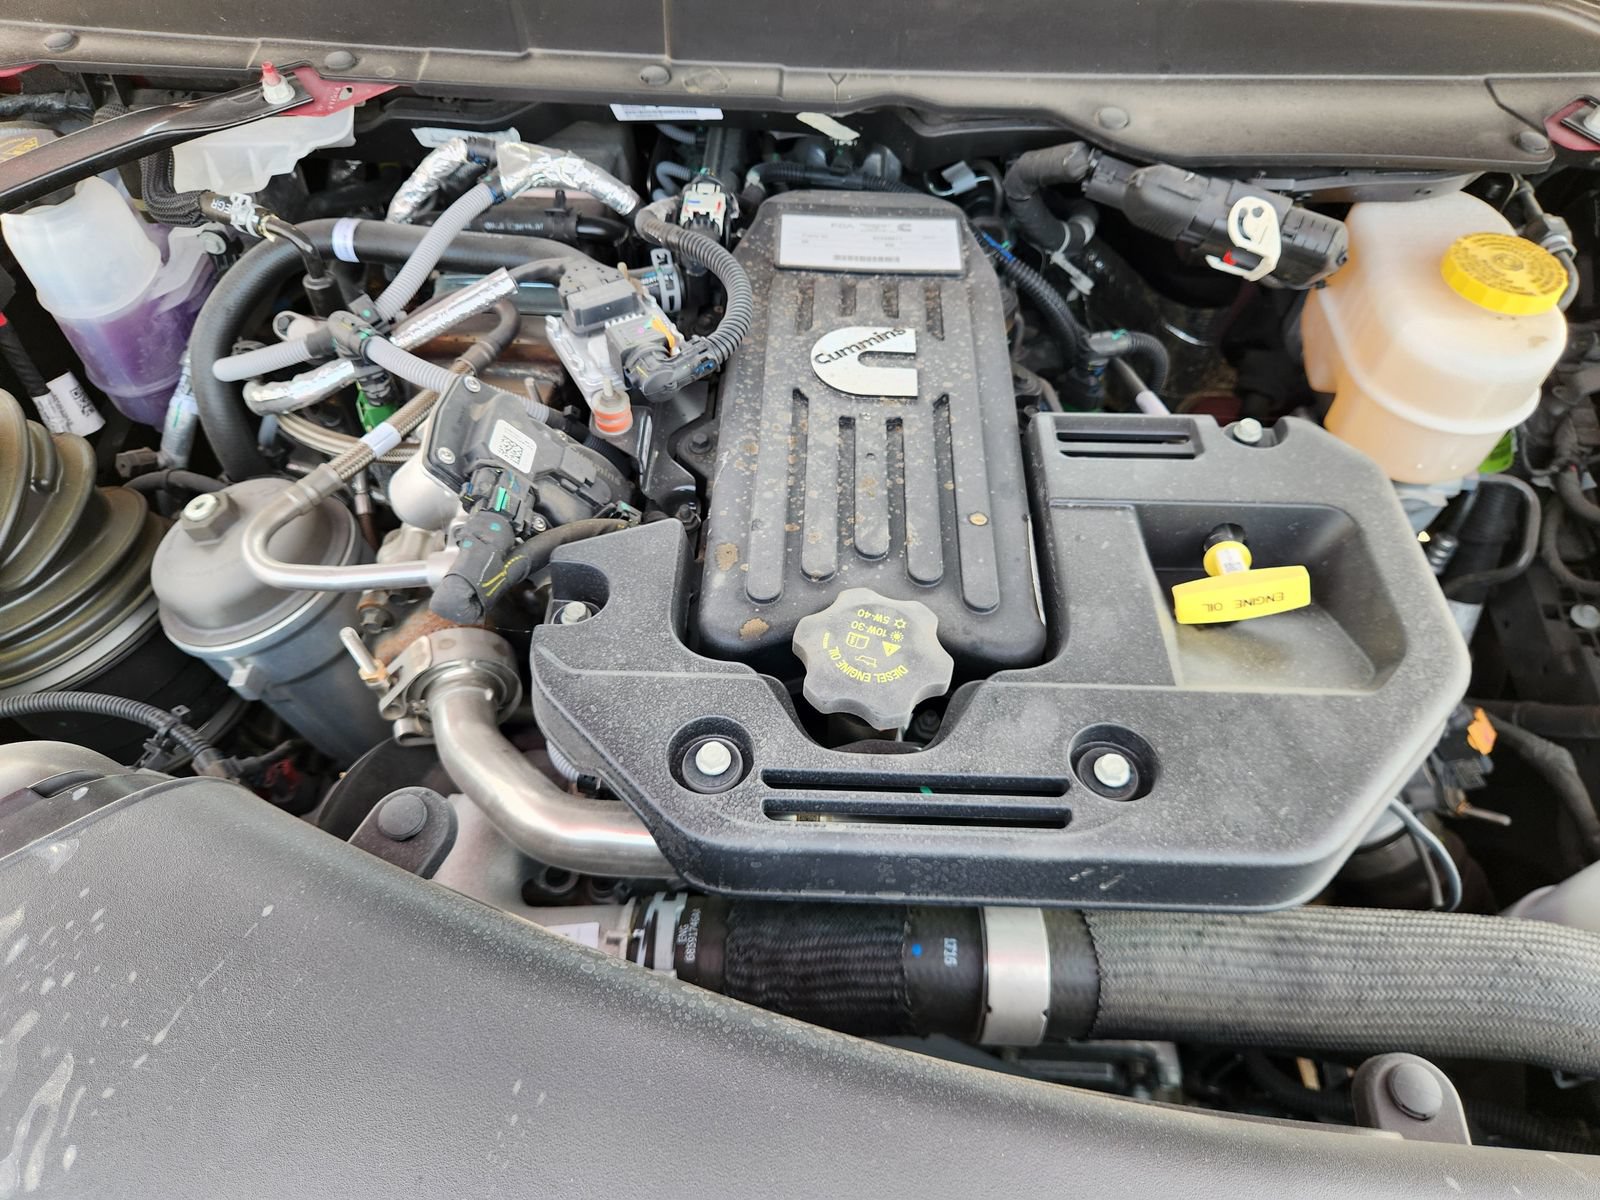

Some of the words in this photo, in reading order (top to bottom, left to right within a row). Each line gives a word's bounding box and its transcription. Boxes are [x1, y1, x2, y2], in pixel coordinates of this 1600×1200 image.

[211, 198, 232, 214] EGR
[814, 328, 906, 364] Cummins
[1202, 602, 1223, 612] OIL
[1234, 592, 1284, 608] ENGINE
[857, 609, 890, 624] 5W-40
[851, 620, 887, 637] 10W-30
[829, 646, 841, 660] OIL
[836, 659, 871, 682] ENGINE
[875, 664, 908, 682] DIESEL
